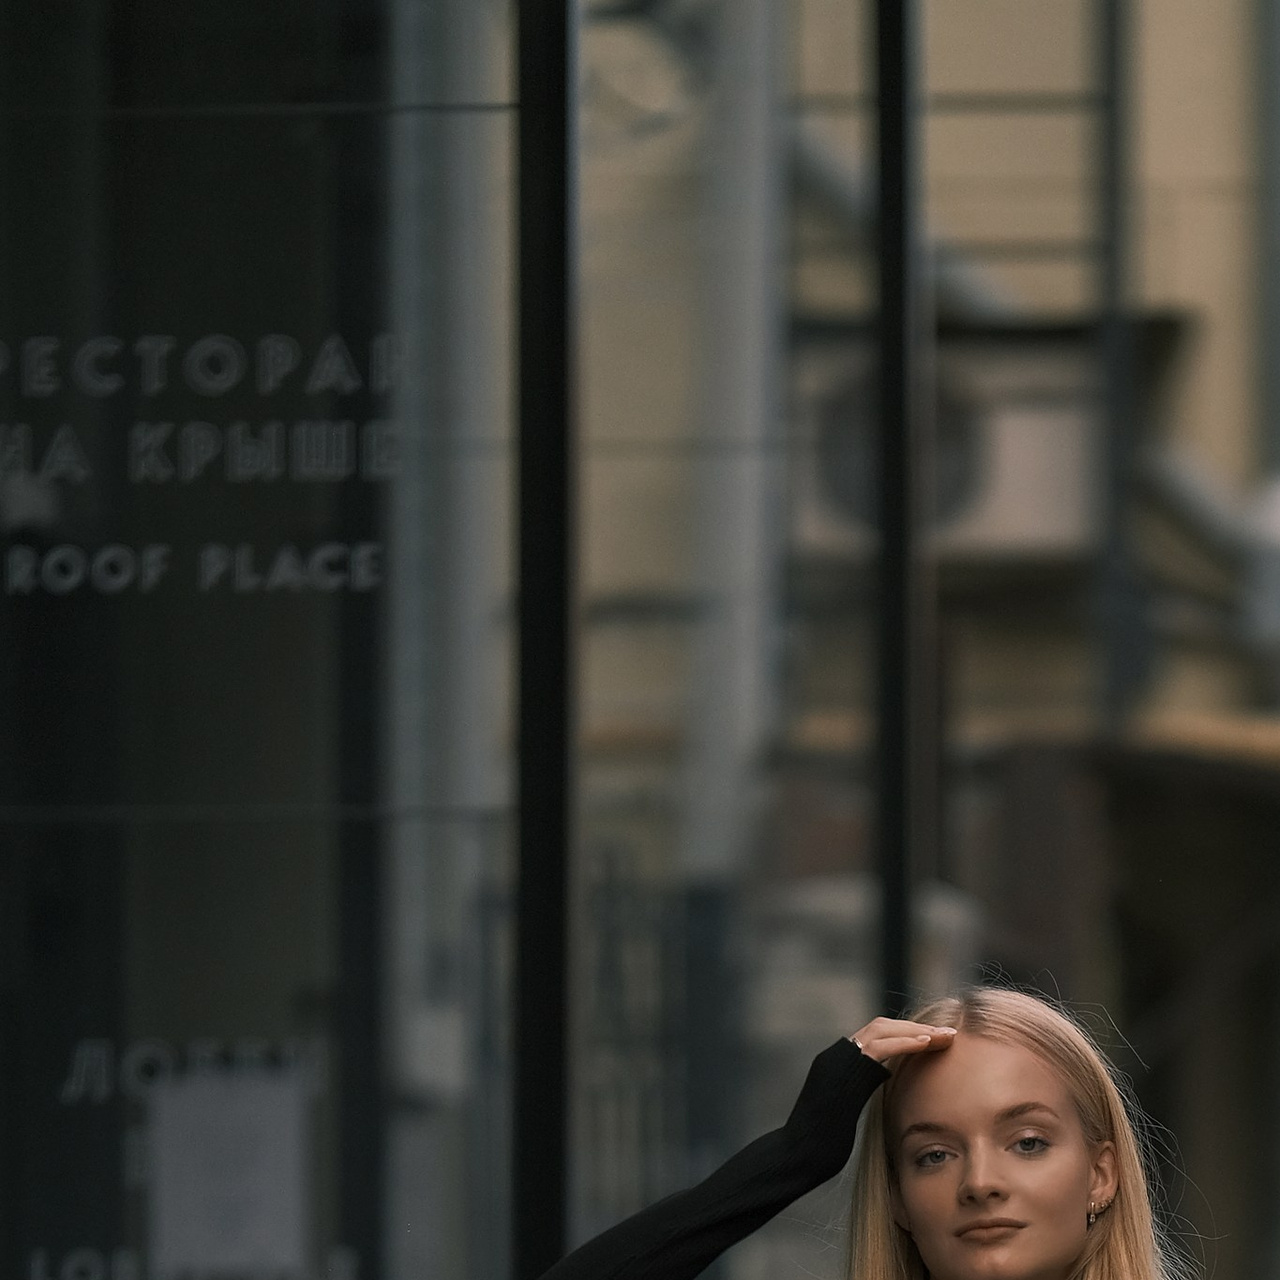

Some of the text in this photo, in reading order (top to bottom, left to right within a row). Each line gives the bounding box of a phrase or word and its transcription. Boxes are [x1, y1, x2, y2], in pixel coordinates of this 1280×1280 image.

[0, 333, 411, 397] ЕСТОРАН
[128, 420, 404, 483] КРЫШЕ
[5, 542, 385, 594] ROOF PLACE
